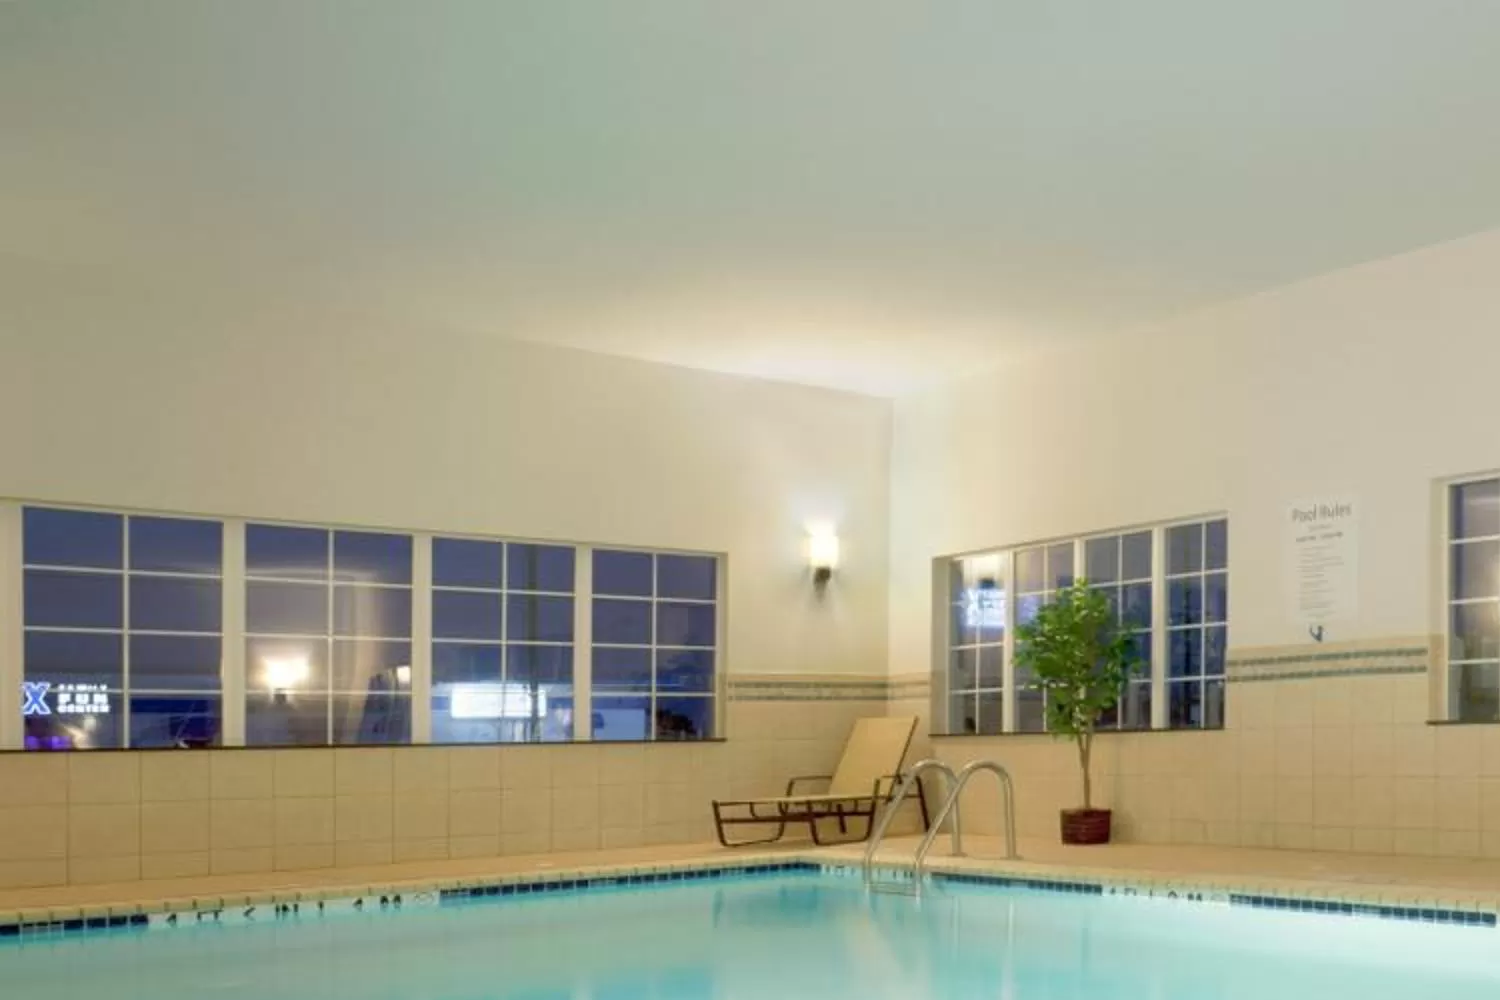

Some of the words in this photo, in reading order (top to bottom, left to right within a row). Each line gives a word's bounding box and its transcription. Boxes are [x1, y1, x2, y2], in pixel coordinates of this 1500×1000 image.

[1292, 503, 1317, 522] Pool
[1319, 500, 1352, 520] Rules
[57, 693, 108, 704] FUN
